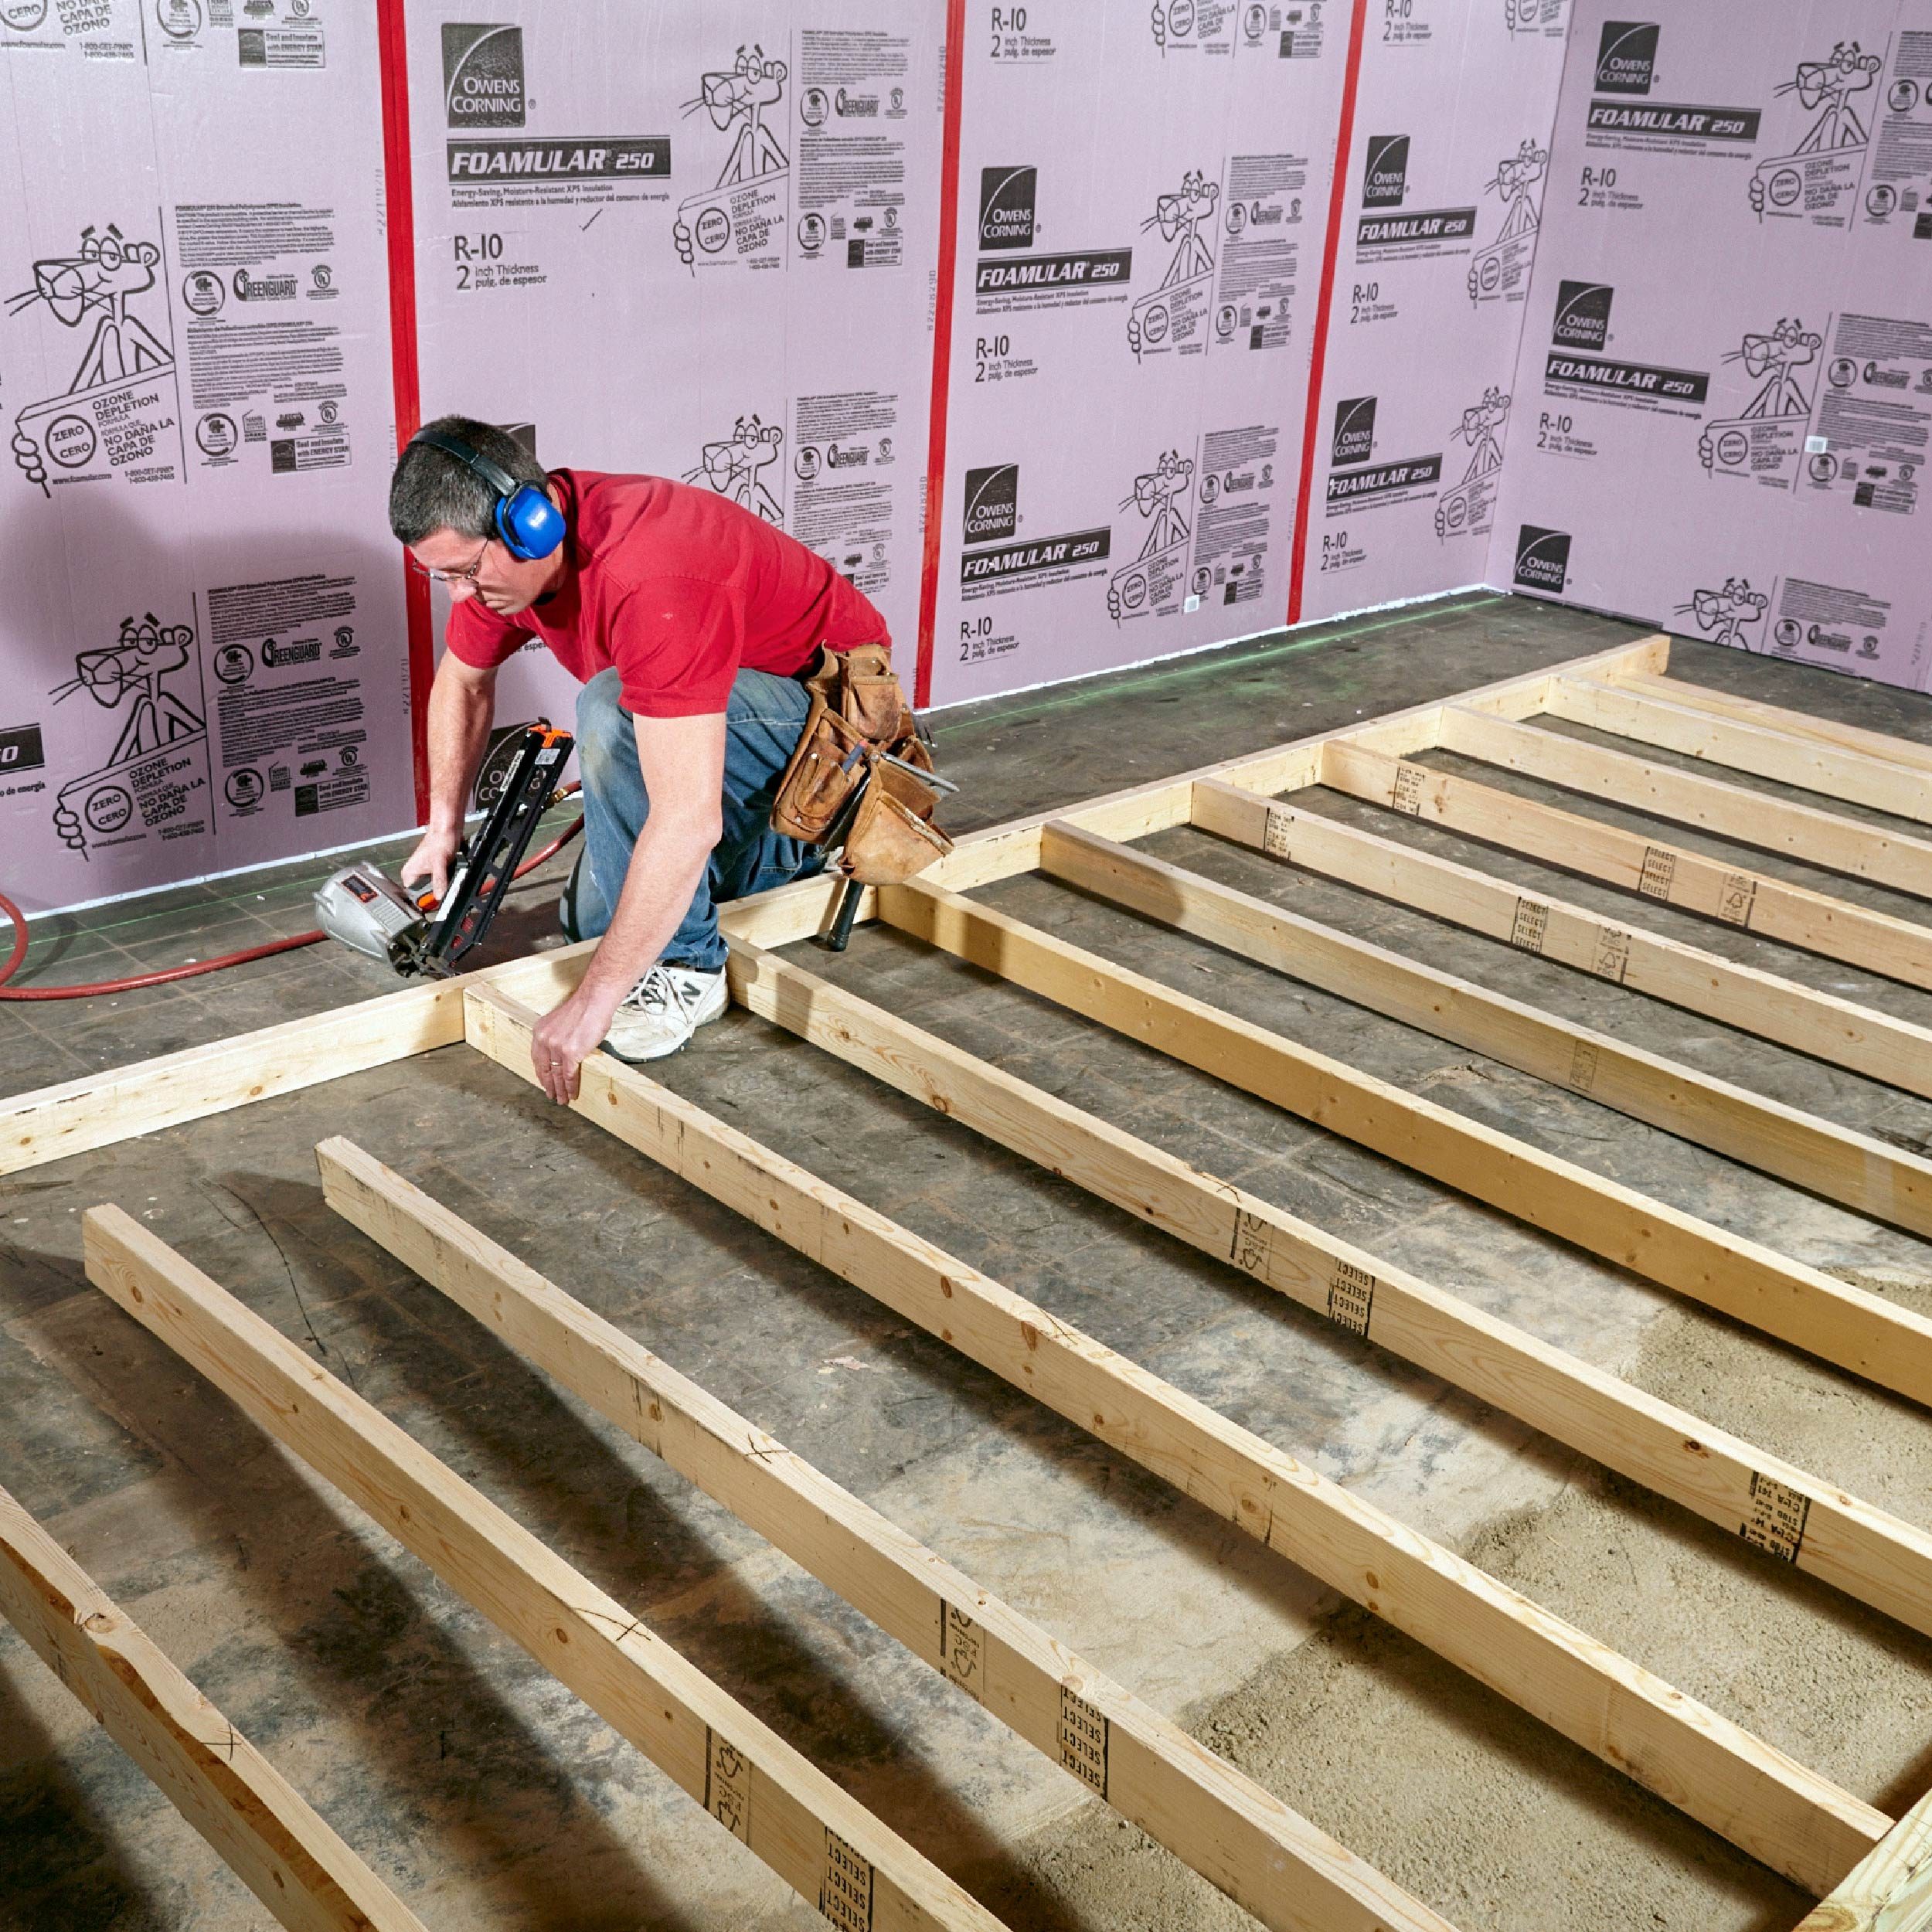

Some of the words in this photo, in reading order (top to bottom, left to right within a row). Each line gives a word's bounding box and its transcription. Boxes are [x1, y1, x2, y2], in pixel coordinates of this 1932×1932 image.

[9, 4, 41, 19] CERO
[60, 9, 93, 24] CAPA
[95, 5, 112, 16] DE
[1386, 0, 1411, 18] R-10
[63, 18, 110, 36] OZONO
[992, 8, 1026, 32] R-10
[1383, 21, 1391, 41] 2
[991, 35, 1001, 57] 2
[1610, 57, 1651, 72] OWENS
[464, 77, 520, 94] OWENS
[1600, 70, 1648, 84] CORNING
[452, 96, 521, 114] CORNING
[1711, 120, 1745, 133] 250
[615, 152, 655, 169] 250
[1374, 172, 1403, 185] OWENS
[1581, 167, 1616, 187] R-10
[730, 189, 758, 204] OZONE
[1366, 185, 1401, 198] CORNING
[1578, 188, 1589, 206] 2
[732, 193, 776, 213] DEPLETION
[701, 217, 723, 230] ZERO
[993, 209, 1032, 223] OWENS
[736, 226, 747, 236] NO
[774, 214, 784, 223] LA
[984, 224, 1030, 238] CORNING
[1444, 220, 1467, 233] 250
[705, 233, 726, 244] CERO
[737, 233, 757, 245] CAPA
[759, 229, 770, 238] DE
[454, 233, 503, 261] R-10
[738, 239, 767, 253] OZONO
[456, 265, 471, 291] 2
[475, 266, 494, 277] inch
[495, 264, 539, 275] Thickness
[1091, 263, 1120, 277] 250
[475, 277, 498, 290] pulg.
[499, 277, 511, 286] de
[513, 275, 547, 287] espesor
[1353, 282, 1378, 303] R-10
[1351, 306, 1359, 324] 2
[1566, 314, 1605, 330] OWENS
[1557, 325, 1603, 342] CORNING
[976, 335, 1010, 359] R-10
[975, 362, 985, 383] 2
[989, 362, 1002, 371] inch
[1004, 359, 1032, 369] Thickness
[1014, 367, 1038, 377] espesor
[1663, 381, 1694, 394] 250
[93, 390, 134, 410] OZONE
[96, 393, 160, 420] DEPLETION
[1540, 412, 1572, 434] R-10
[53, 425, 84, 442] ZERO
[104, 435, 122, 447] NO
[124, 423, 158, 440] DAÑA
[158, 417, 175, 430] LA
[1342, 430, 1370, 444] OWENS
[1537, 432, 1546, 447] 2
[60, 442, 90, 458] CERO
[108, 441, 138, 456] CAPA
[139, 434, 155, 447] DE
[1335, 442, 1369, 457] CORNING
[111, 446, 153, 466] OZONO
[1411, 466, 1433, 479] 250
[977, 503, 1014, 519] OWENS
[968, 517, 1013, 532] CORNING
[1073, 541, 1099, 557] 250
[1323, 531, 1347, 552] R-10
[1321, 554, 1328, 570] 2
[1527, 556, 1564, 573] OWENS
[1519, 566, 1562, 584] CORNING
[961, 617, 992, 640] R-10
[973, 641, 985, 649] inch
[987, 635, 1014, 646] Thickness
[997, 641, 1019, 652] espesor
[960, 643, 968, 662] 2
[129, 757, 168, 779] OZONE
[131, 757, 191, 787] DEPLETION
[6, 787, 15, 795] de
[140, 798, 156, 810] NO
[158, 784, 190, 802] DAÑA
[190, 777, 206, 788] LA
[92, 794, 121, 811] ZERO
[142, 802, 171, 818] CAPA
[172, 794, 187, 806] DE
[98, 808, 127, 825] CERO
[145, 805, 185, 827] OZONO
[1649, 848, 1675, 862] SELECT
[1648, 859, 1672, 874] SELECT
[1645, 871, 1670, 886] SELECT
[1642, 883, 1668, 900] SELECT
[1522, 900, 1546, 916] SELECT
[1519, 913, 1543, 928] SELECT
[1518, 924, 1541, 940] SELECT
[1337, 1260, 1368, 1286] SELECT
[1335, 1277, 1366, 1302] SELECT
[1334, 1294, 1365, 1318] SELECT
[1063, 1706, 1101, 1743] SELECT
[1063, 1728, 1100, 1766] SELECT
[1063, 1750, 1100, 1788] SELECT
[828, 1842, 866, 1886] SELECT
[828, 1866, 866, 1910] SELECT
[827, 1890, 865, 1932] SELECT
